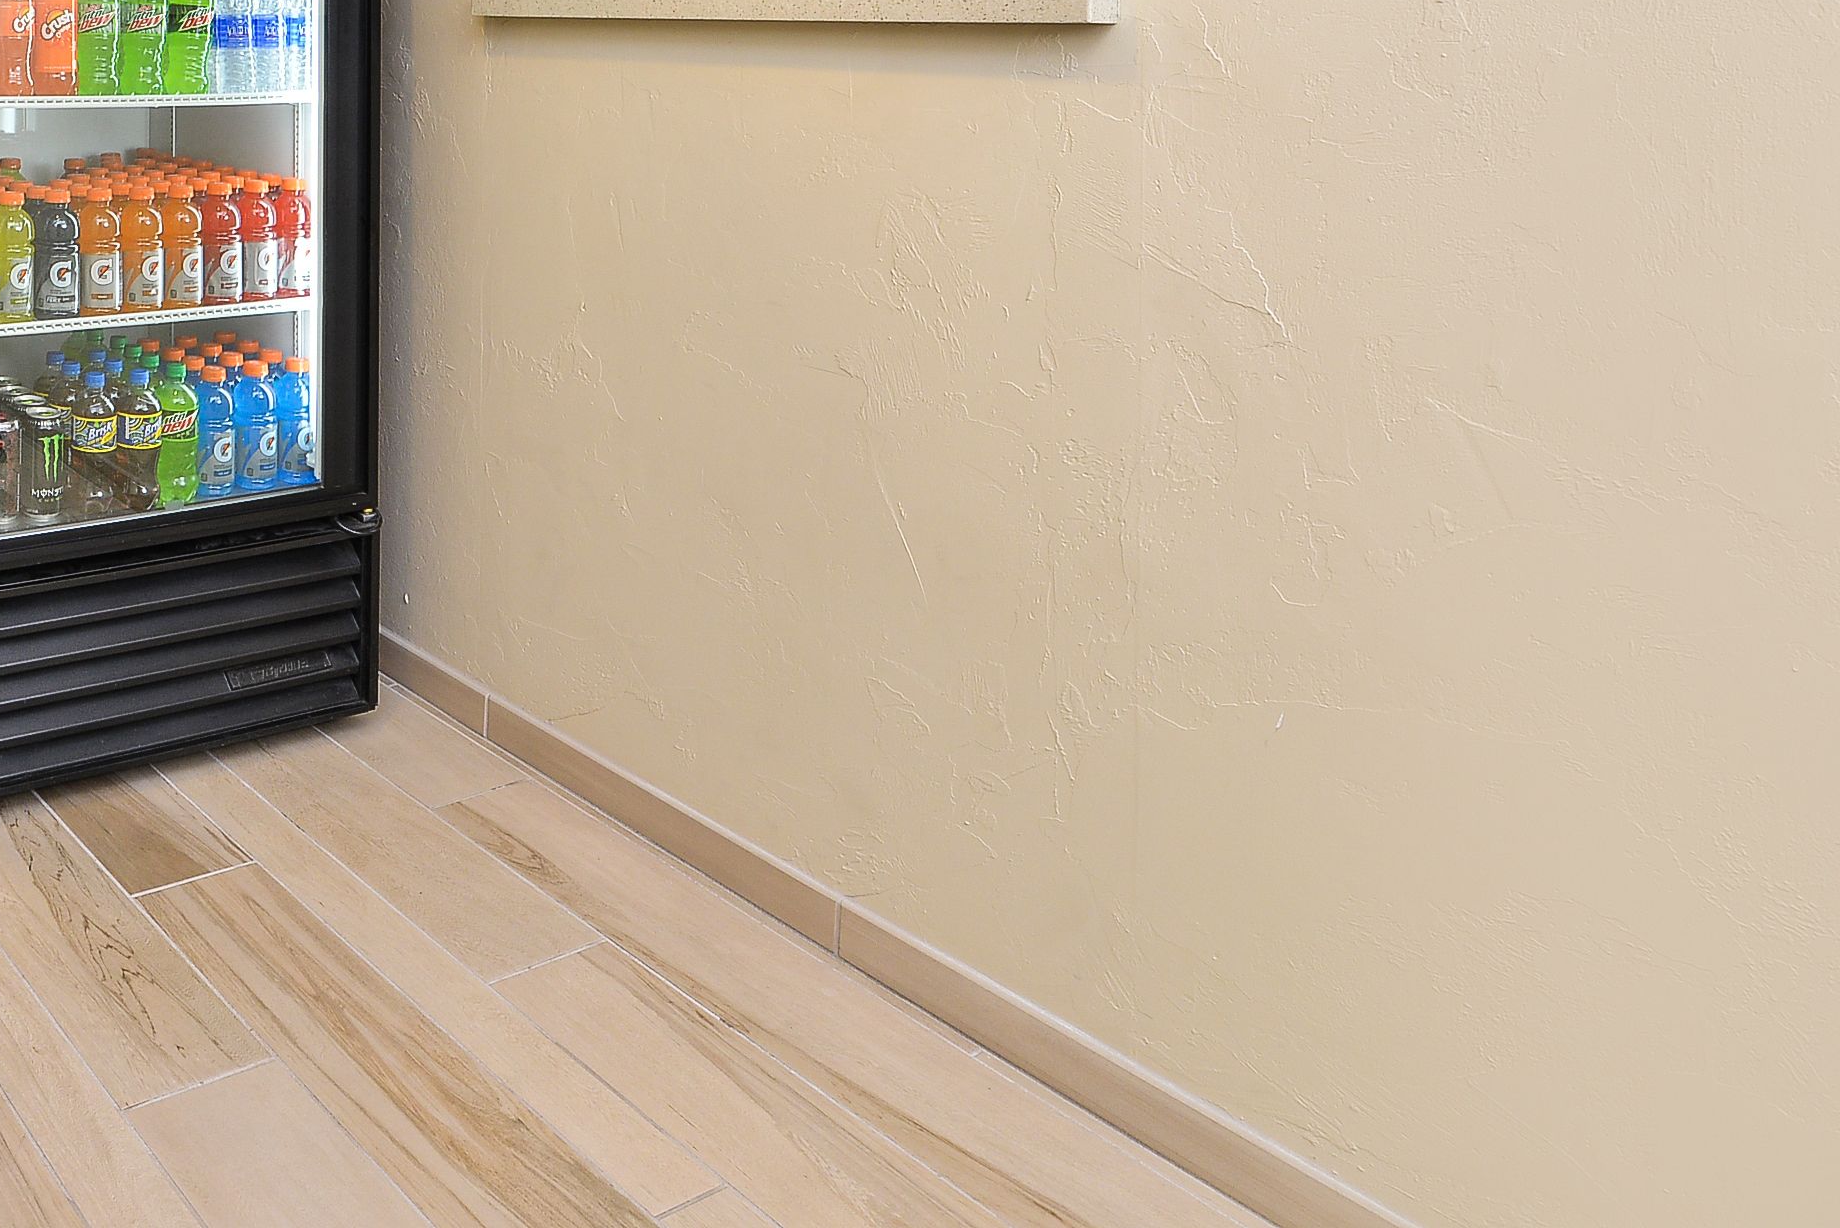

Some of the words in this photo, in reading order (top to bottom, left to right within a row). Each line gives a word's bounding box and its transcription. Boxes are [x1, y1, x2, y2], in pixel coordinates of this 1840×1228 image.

[41, 9, 75, 40] Crush
[50, 260, 72, 288] G
[91, 259, 113, 285] G
[88, 420, 112, 441] Brisk
